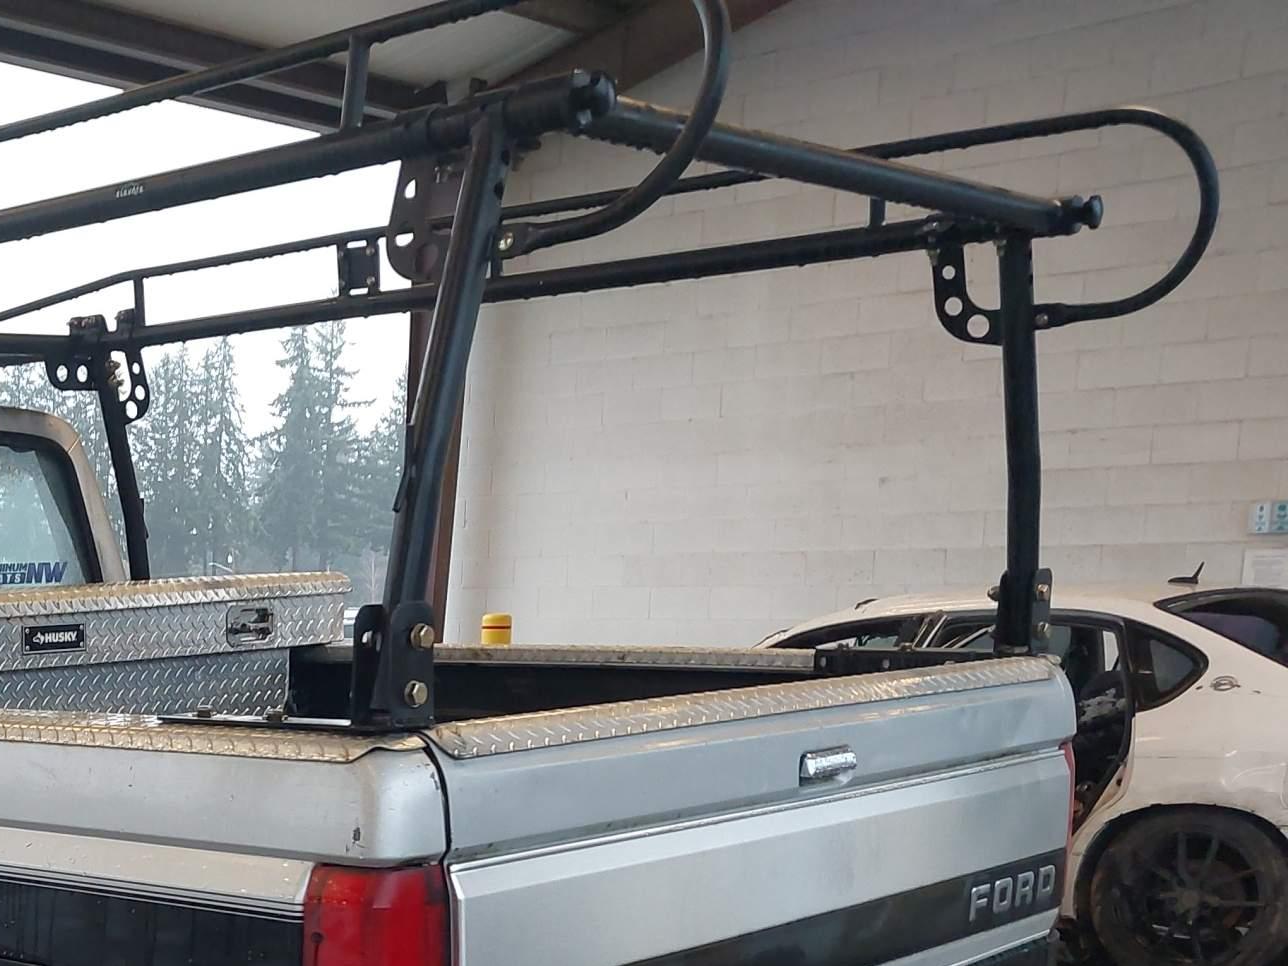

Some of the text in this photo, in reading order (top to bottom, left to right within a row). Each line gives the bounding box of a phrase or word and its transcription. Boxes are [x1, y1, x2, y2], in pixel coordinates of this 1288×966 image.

[27, 562, 68, 584] NW
[45, 632, 77, 643] HUSKY
[969, 864, 1056, 922] FORD
